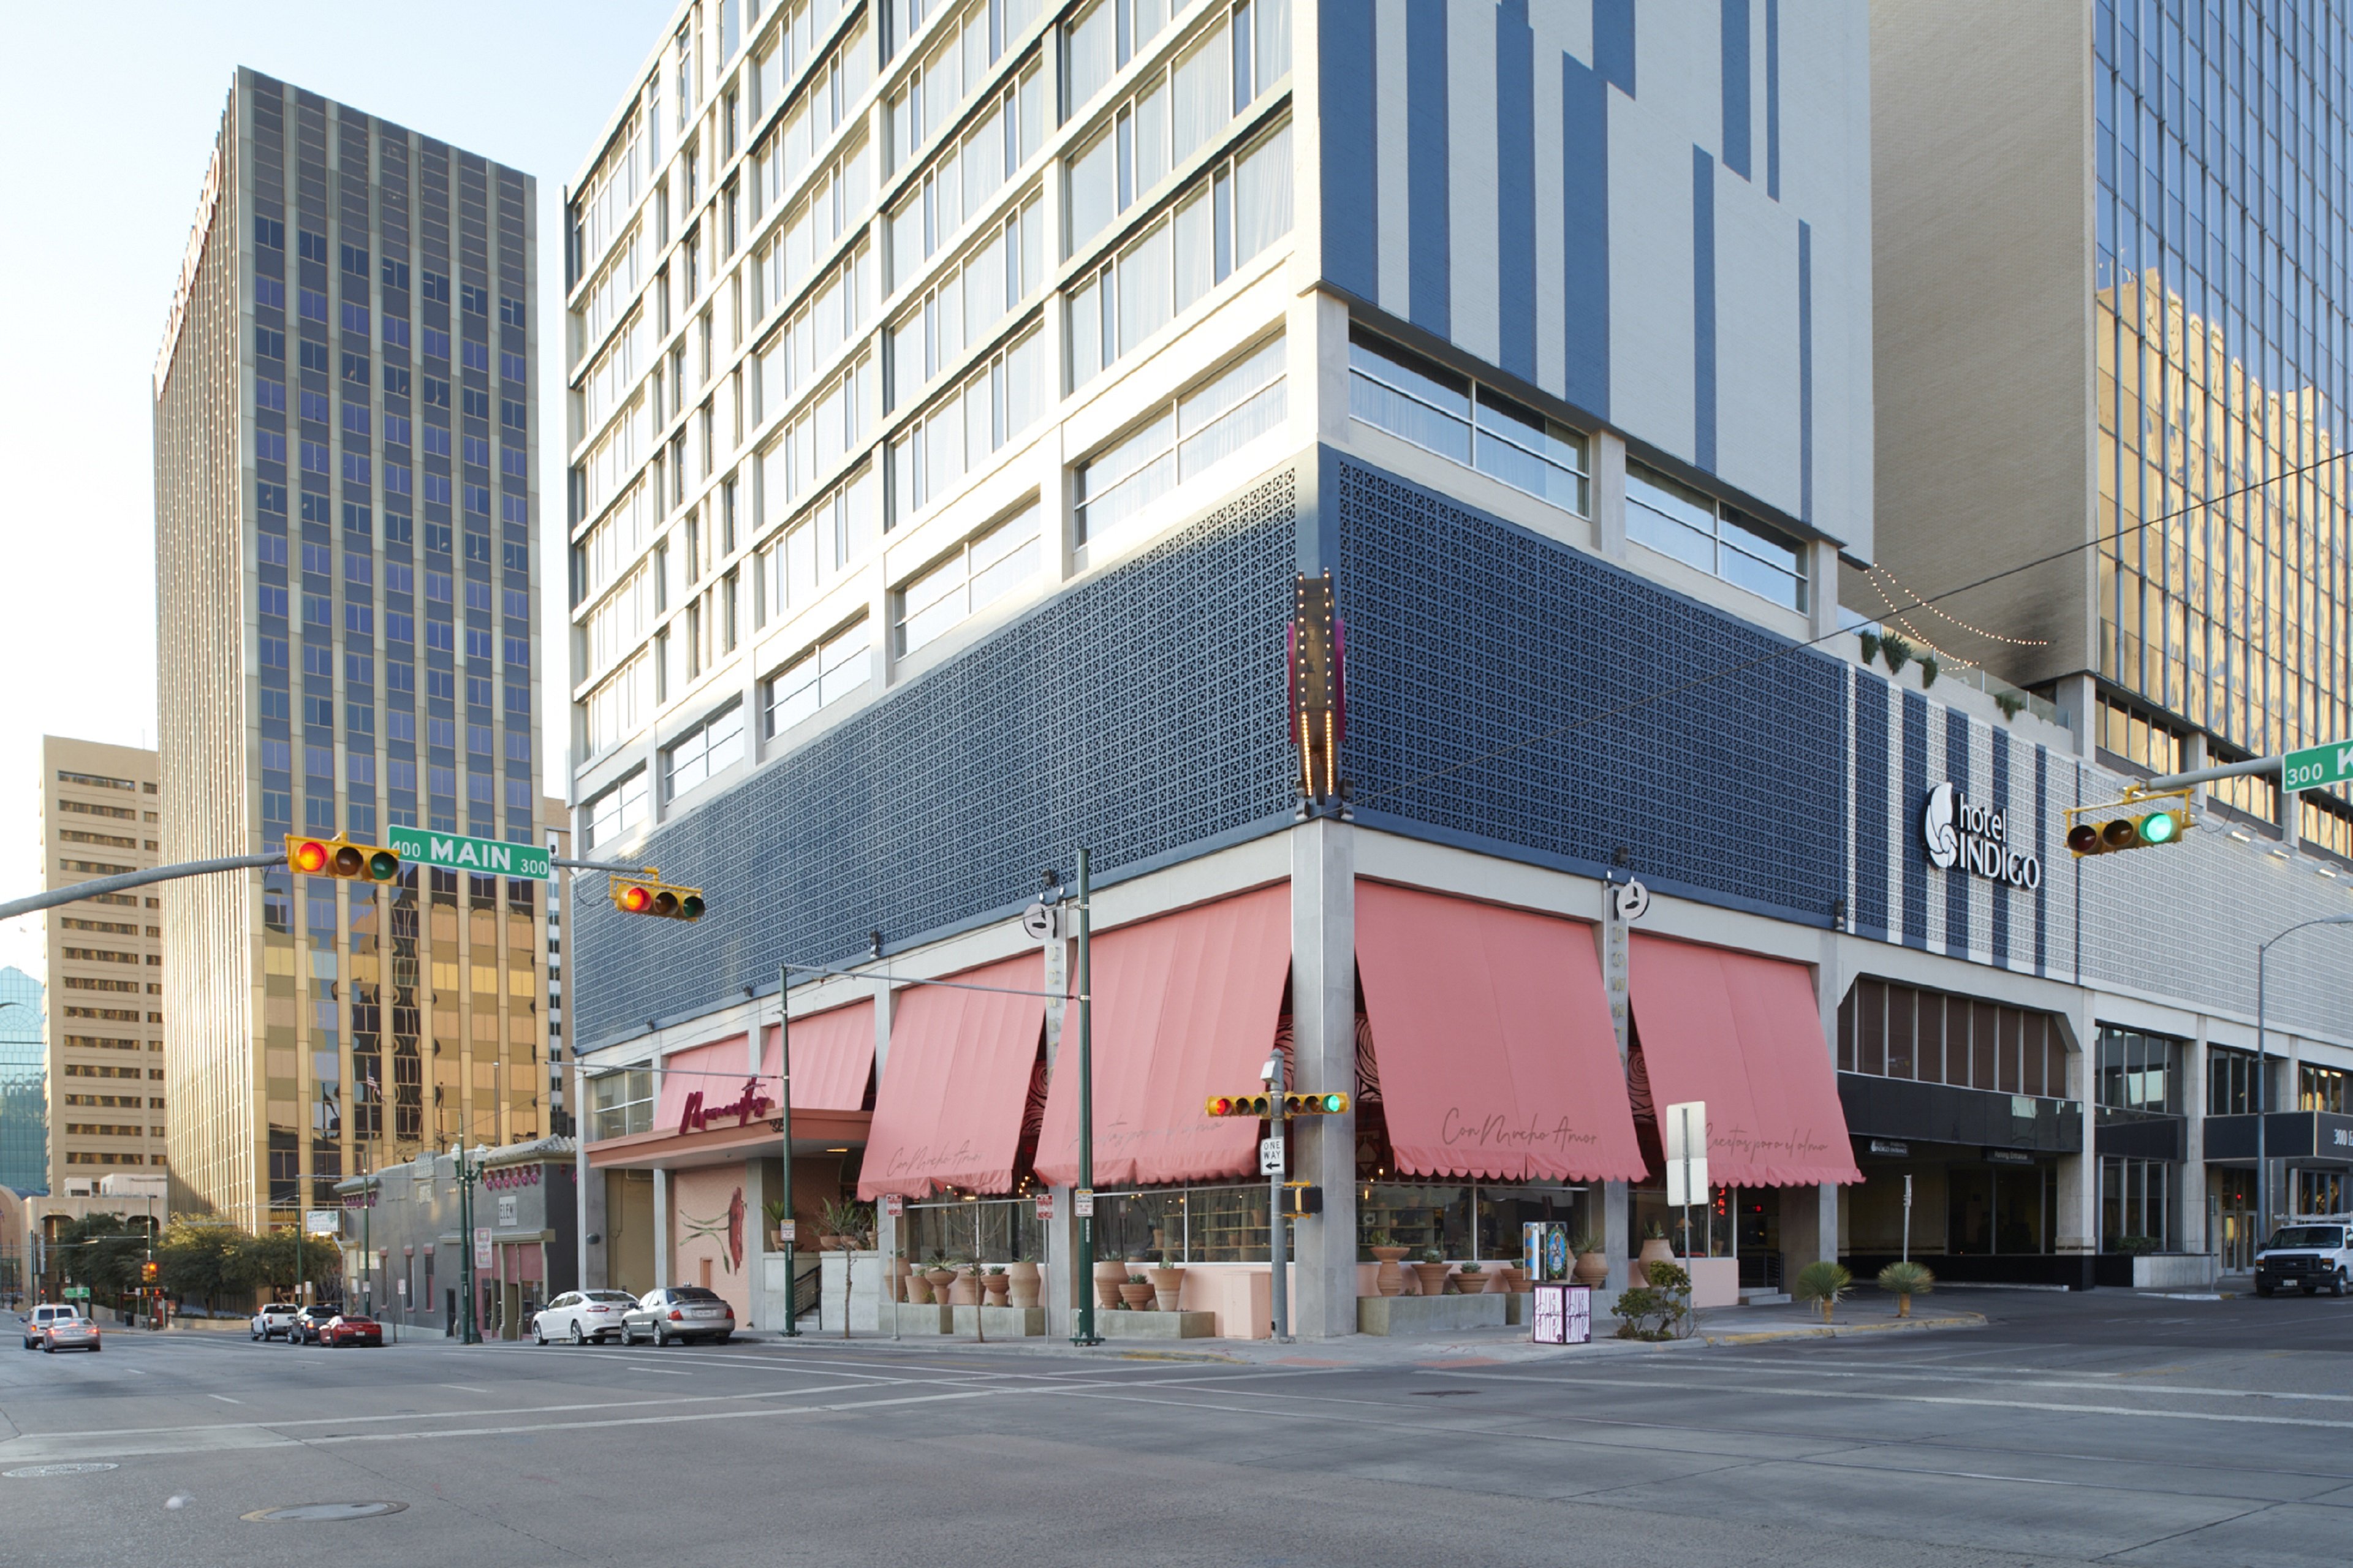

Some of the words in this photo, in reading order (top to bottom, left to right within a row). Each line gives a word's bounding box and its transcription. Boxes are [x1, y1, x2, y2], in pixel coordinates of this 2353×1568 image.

[2287, 762, 2324, 786] 300
[1960, 793, 2006, 843] hotel
[431, 836, 511, 871] MAIN
[520, 858, 548, 875] 300
[1960, 831, 2040, 889] INDIGO
[1264, 1141, 1281, 1151] ONE
[1442, 1107, 1480, 1145] Con
[1480, 1113, 1548, 1147] Mucho
[1552, 1116, 1597, 1153] Amor
[1749, 1139, 1784, 1164] para
[1798, 1129, 1828, 1159] alma
[2333, 1128, 2348, 1146] 300
[1264, 1151, 1281, 1160] WAY
